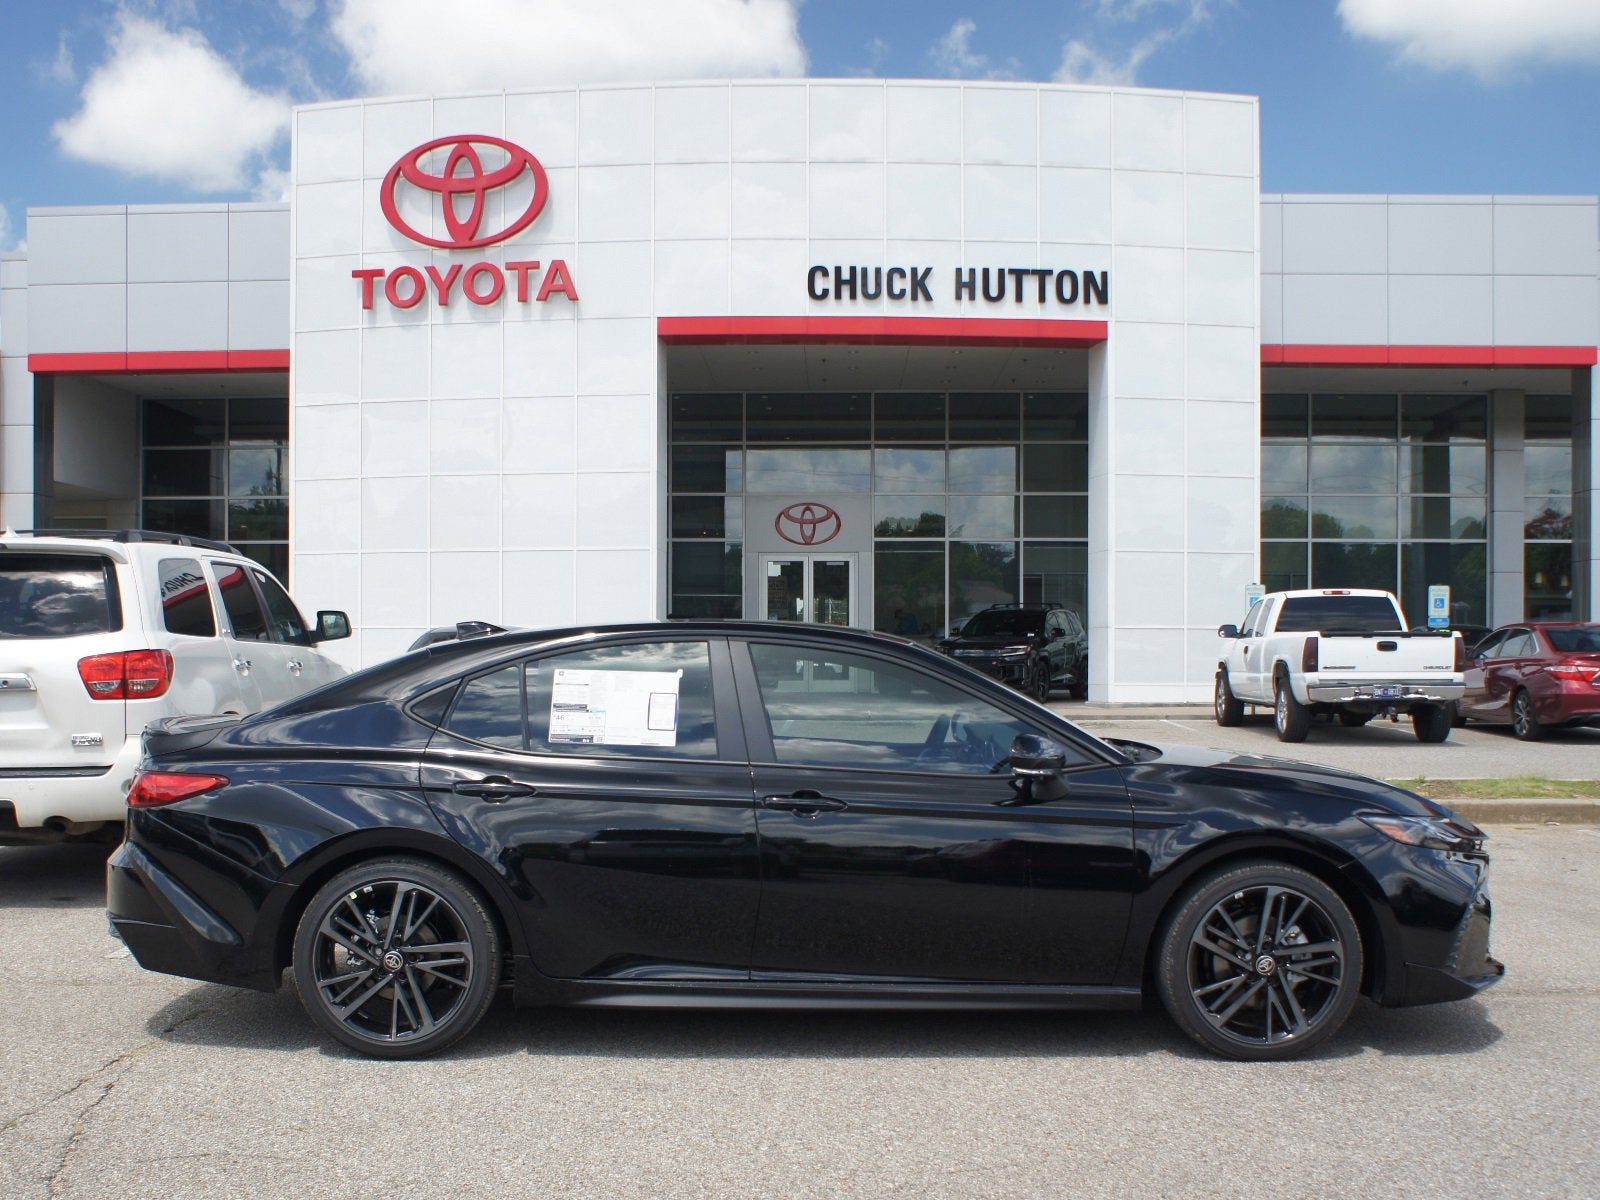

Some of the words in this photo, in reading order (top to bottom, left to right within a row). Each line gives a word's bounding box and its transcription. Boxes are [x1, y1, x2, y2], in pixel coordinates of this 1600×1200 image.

[351, 259, 579, 310] TOYOTA
[807, 265, 934, 302] CHUCK
[954, 267, 1109, 305] HUTTON
